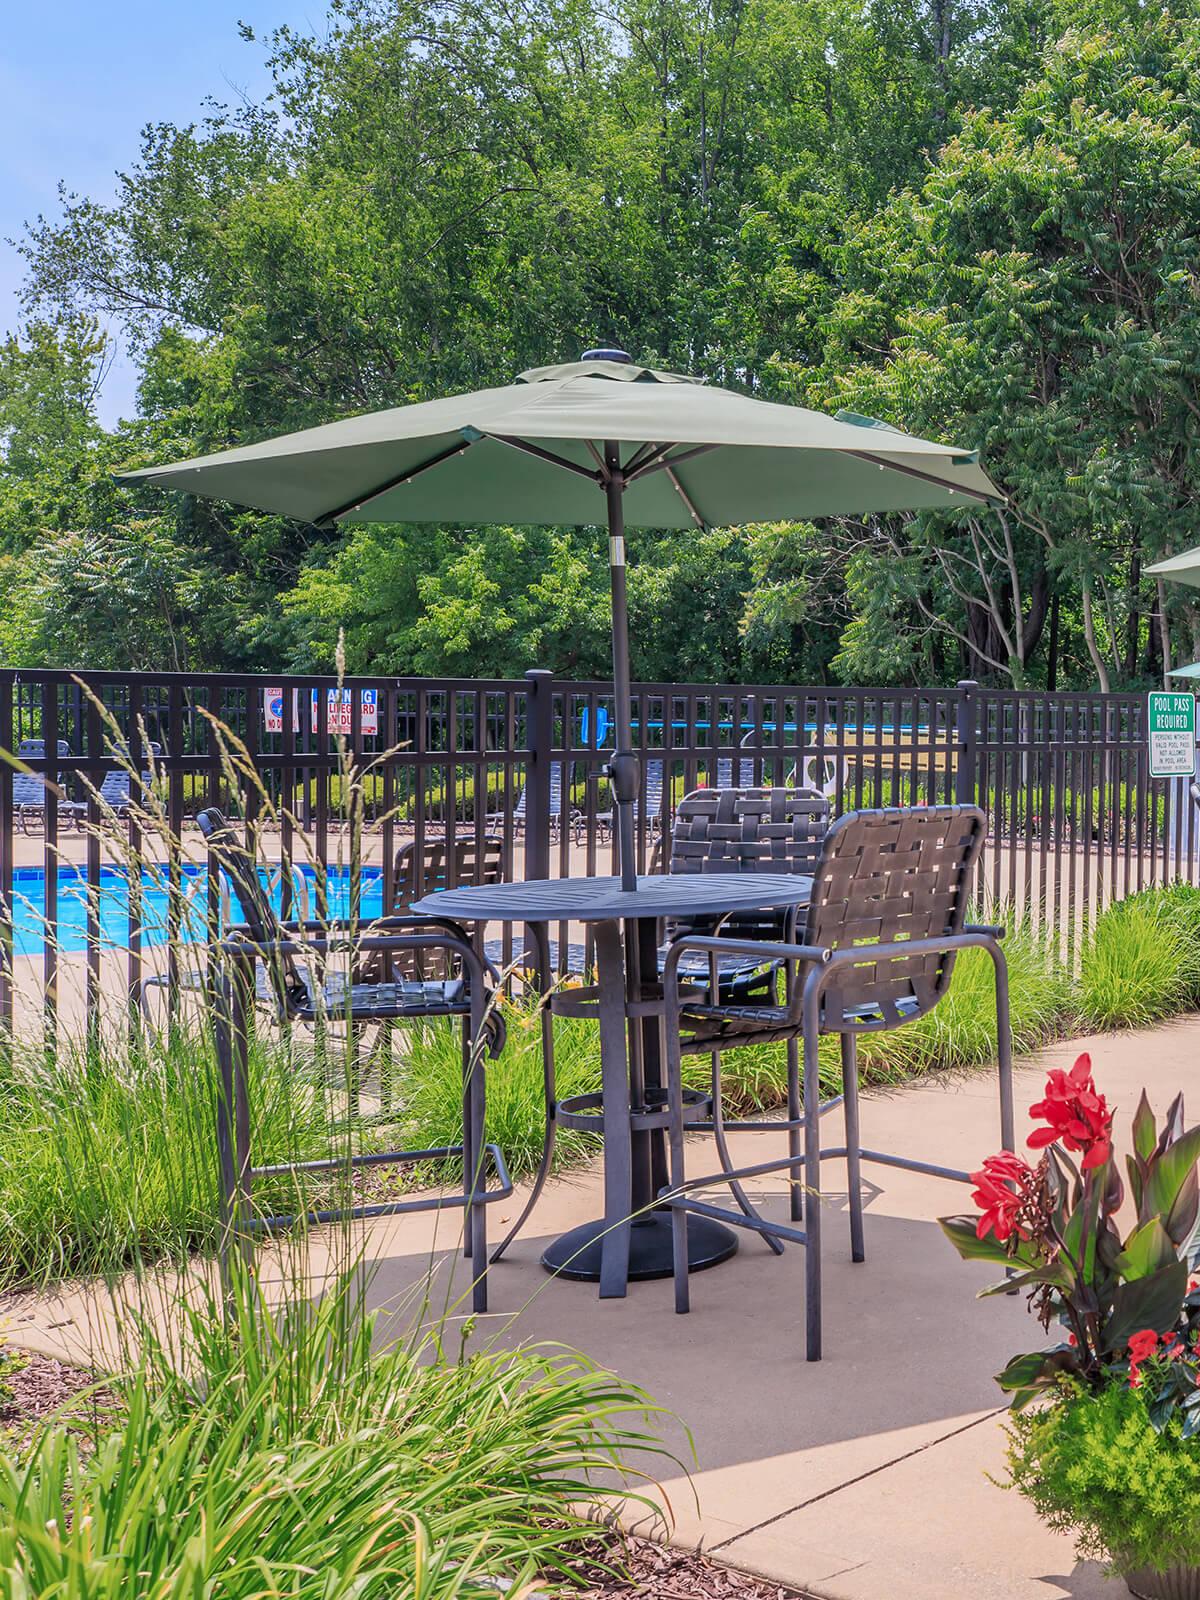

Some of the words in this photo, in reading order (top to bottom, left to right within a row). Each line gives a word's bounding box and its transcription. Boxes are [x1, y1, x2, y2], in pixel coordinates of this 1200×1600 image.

[1154, 697, 1171, 711] POOL
[1174, 698, 1190, 712] PASS
[1156, 714, 1188, 729] REQUIRED
